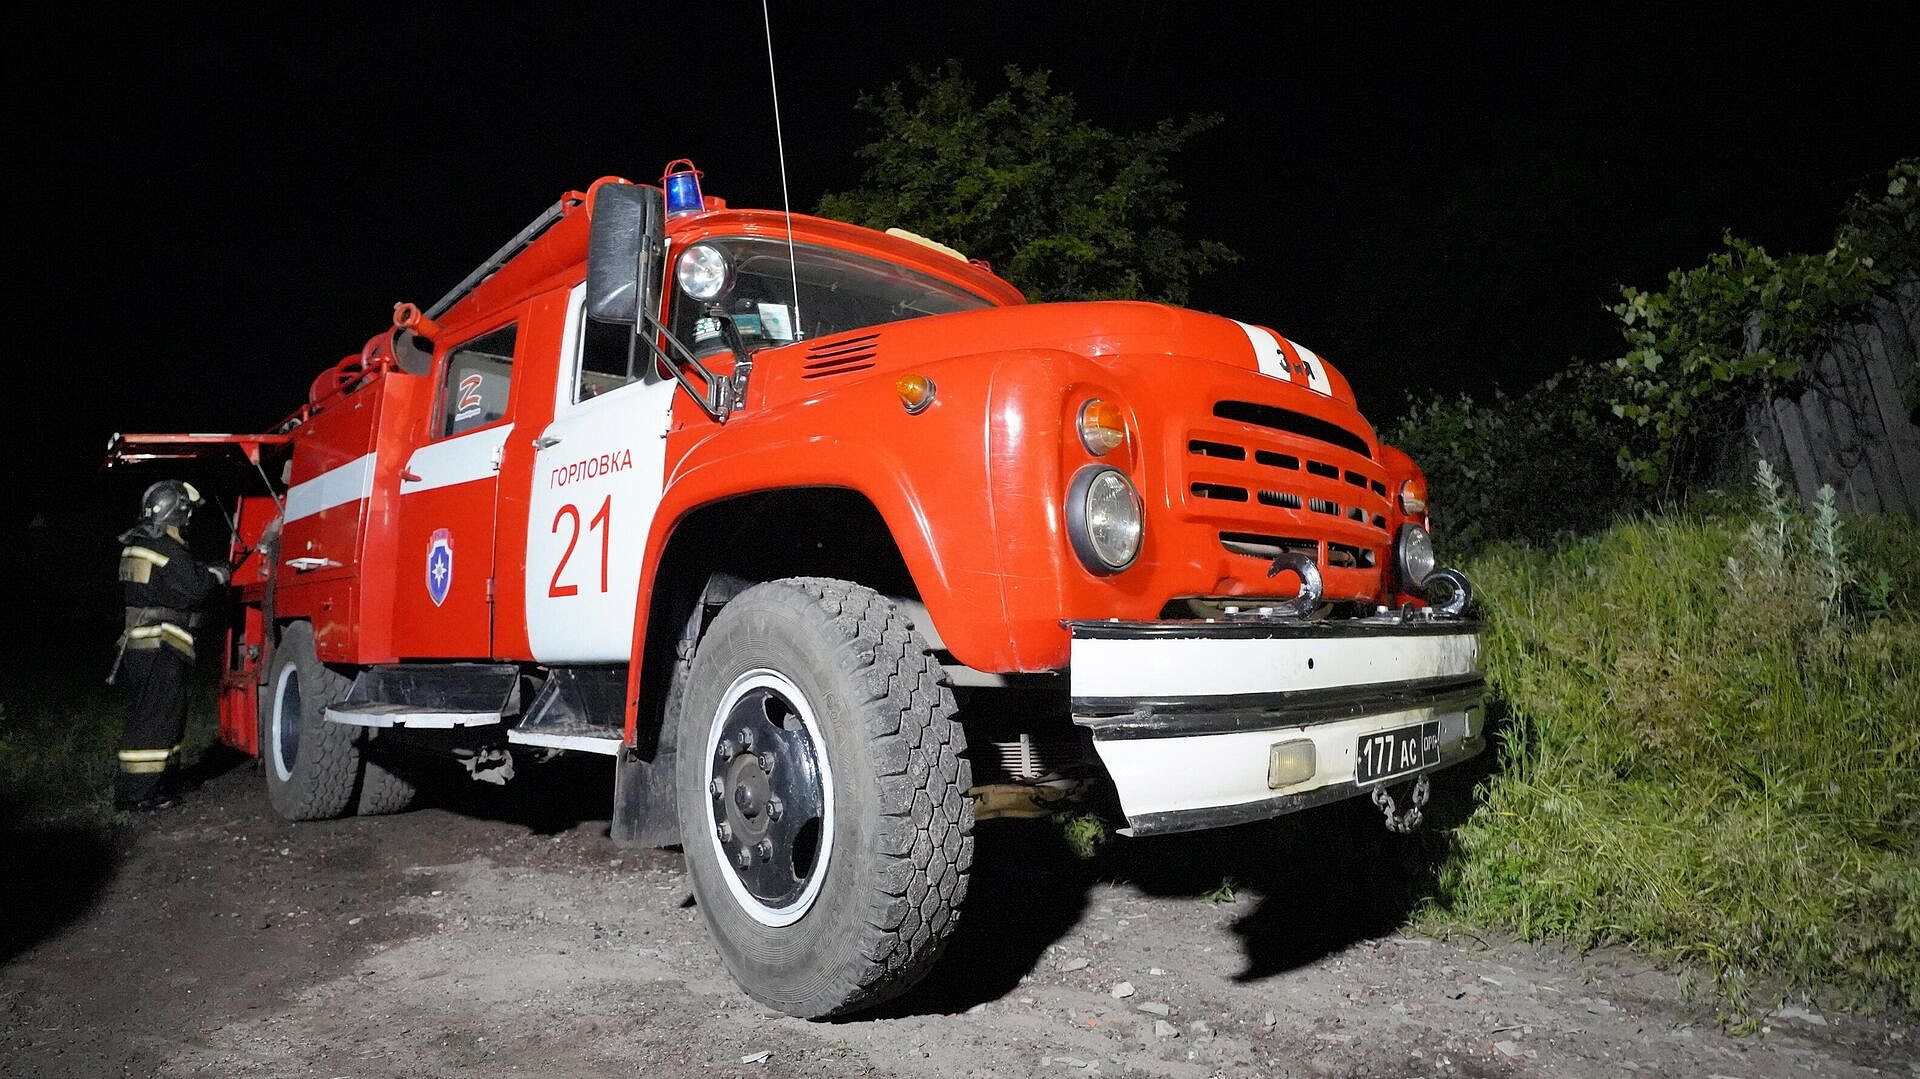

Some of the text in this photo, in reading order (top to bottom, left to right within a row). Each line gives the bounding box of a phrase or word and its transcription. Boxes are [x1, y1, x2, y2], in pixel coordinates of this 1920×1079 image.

[458, 374, 483, 412] Z
[550, 449, 633, 489] ГОРЛОВКА
[548, 494, 611, 598] 21
[1363, 734, 1395, 777] 177
[1400, 738, 1417, 769] AC
